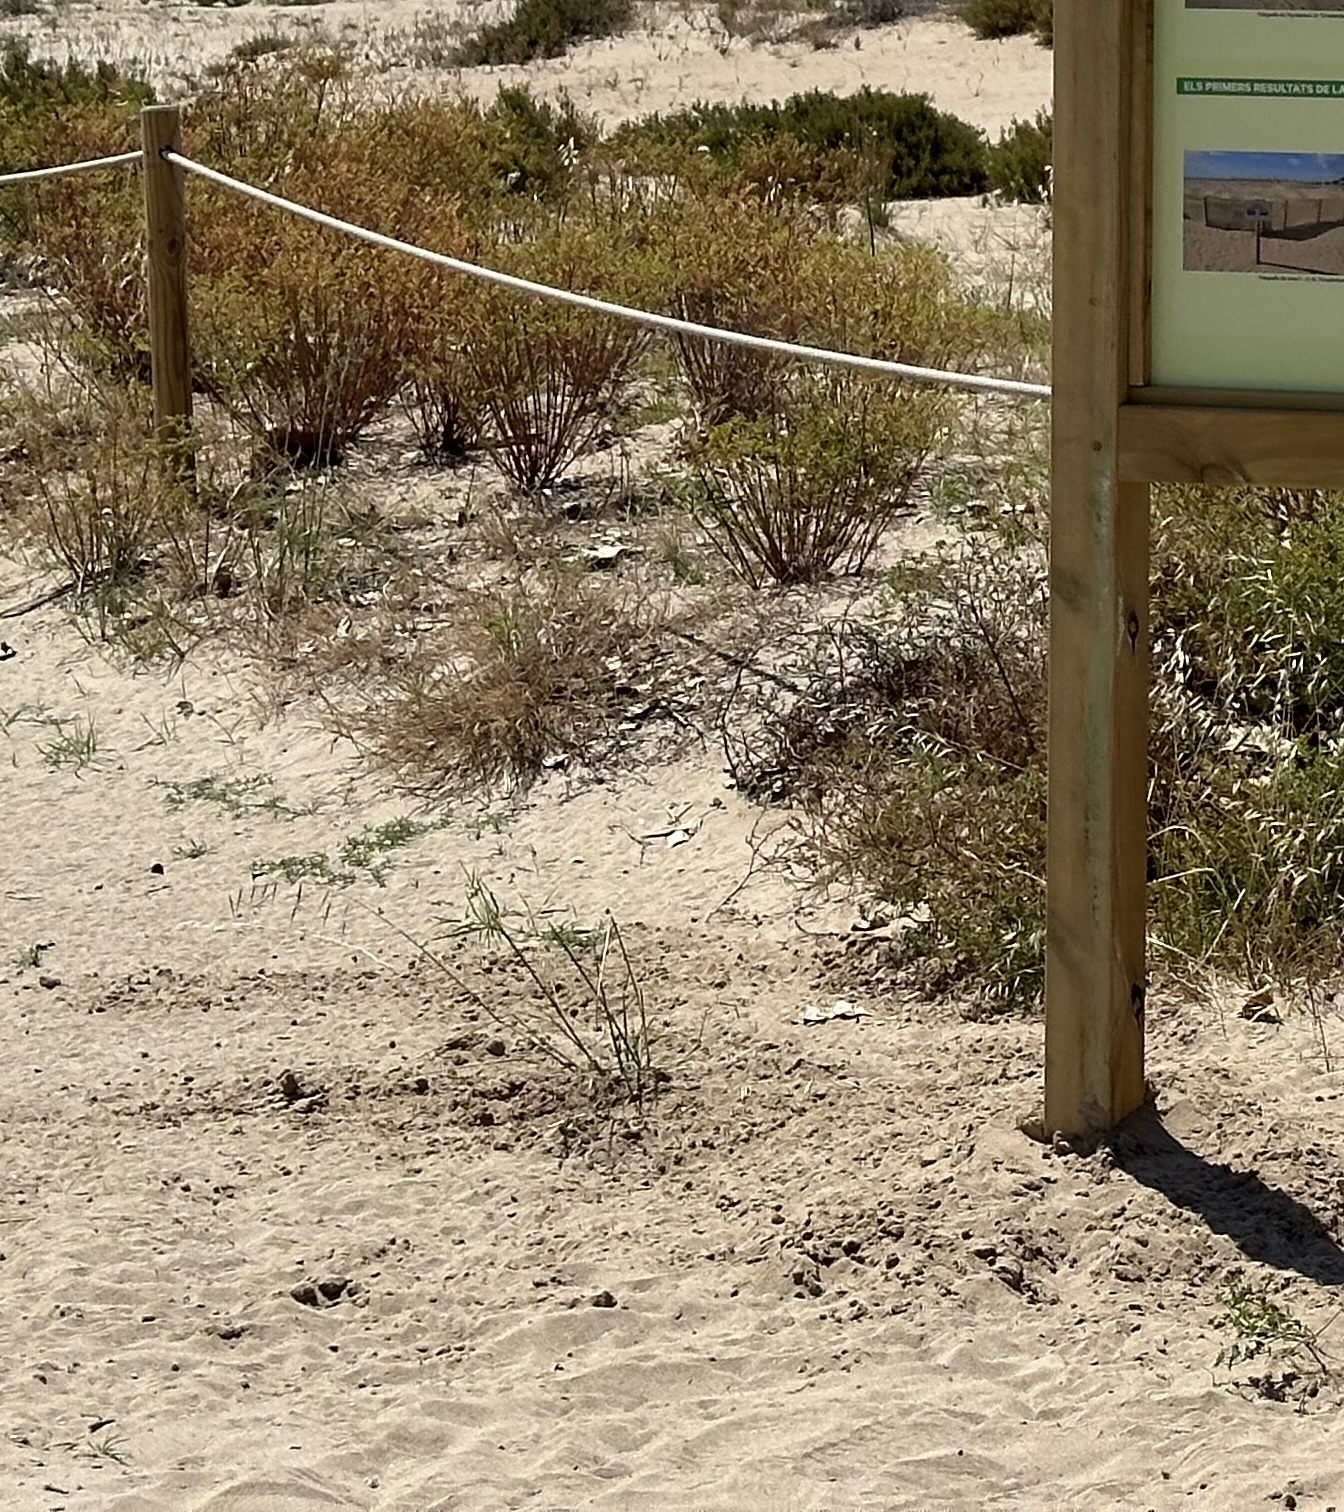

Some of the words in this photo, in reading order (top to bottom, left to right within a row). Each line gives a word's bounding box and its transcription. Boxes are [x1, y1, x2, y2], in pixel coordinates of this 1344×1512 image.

[1184, 81, 1203, 91] ELS
[1205, 82, 1251, 92] PRIMERS
[1254, 83, 1313, 93] RESULTATS
[1316, 84, 1330, 94] DE
